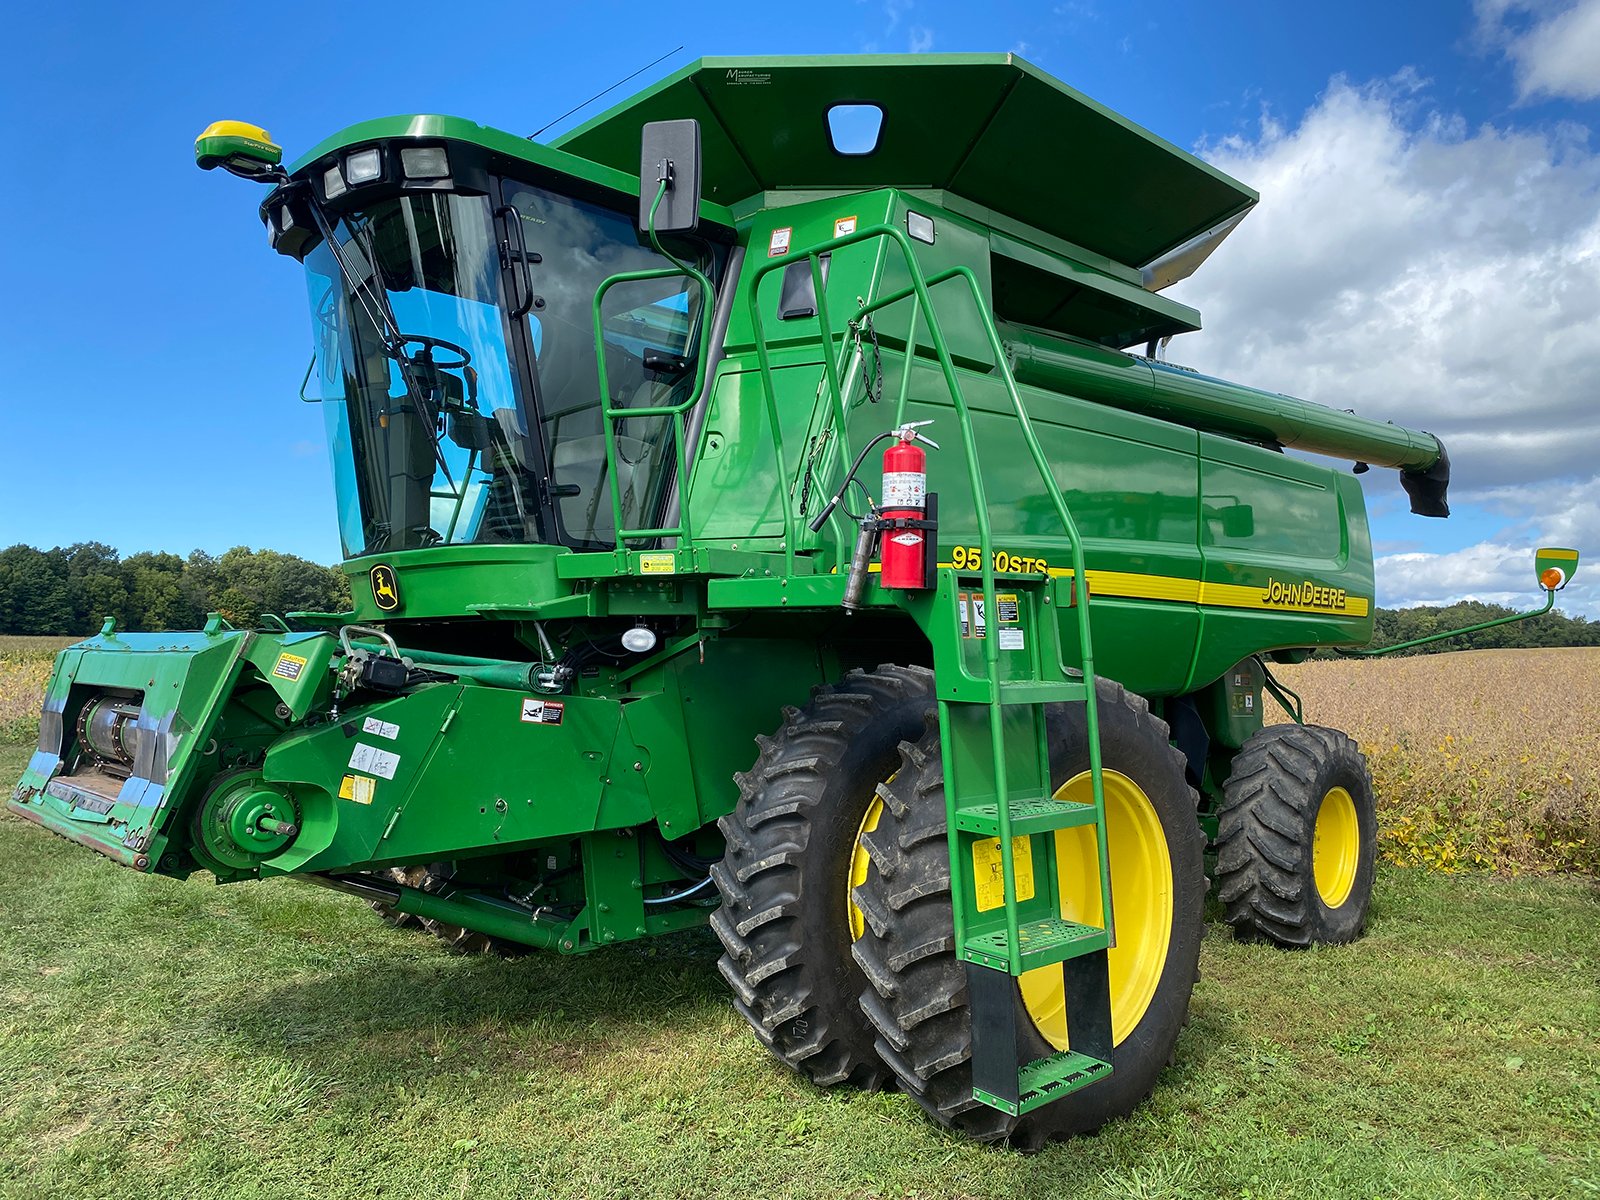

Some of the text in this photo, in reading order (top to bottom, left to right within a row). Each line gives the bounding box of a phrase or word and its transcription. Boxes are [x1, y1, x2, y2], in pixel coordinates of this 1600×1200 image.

[244, 140, 264, 150] StarFire
[952, 545, 1048, 574] 950STS
[285, 654, 305, 664] CAUTION
